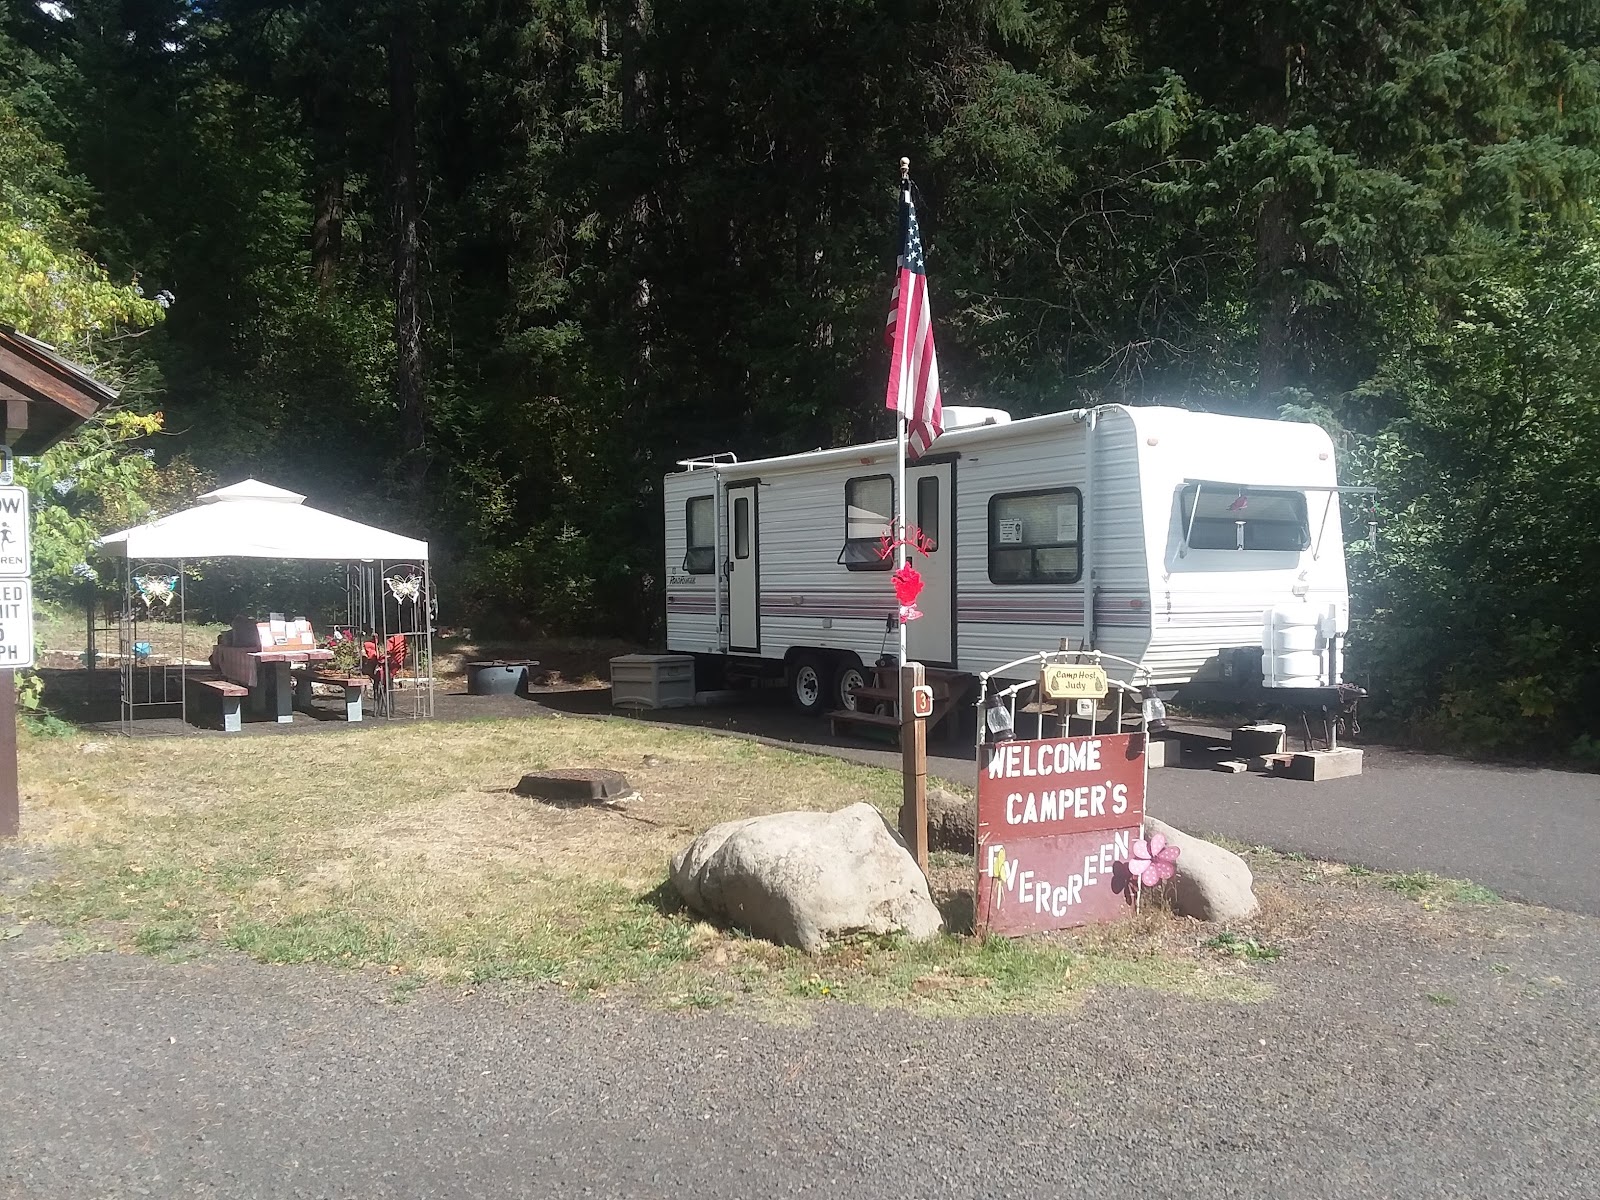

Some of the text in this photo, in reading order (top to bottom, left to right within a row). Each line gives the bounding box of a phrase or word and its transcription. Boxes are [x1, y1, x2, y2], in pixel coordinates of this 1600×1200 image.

[0, 498, 20, 513] W
[0, 587, 22, 600] ED
[0, 604, 20, 618] IT
[1056, 670, 1096, 680] Camp Host
[1065, 681, 1086, 691] Judy
[920, 692, 927, 709] 3
[988, 739, 1102, 780] WELCOME
[1006, 780, 1128, 825] CAMPER'S
